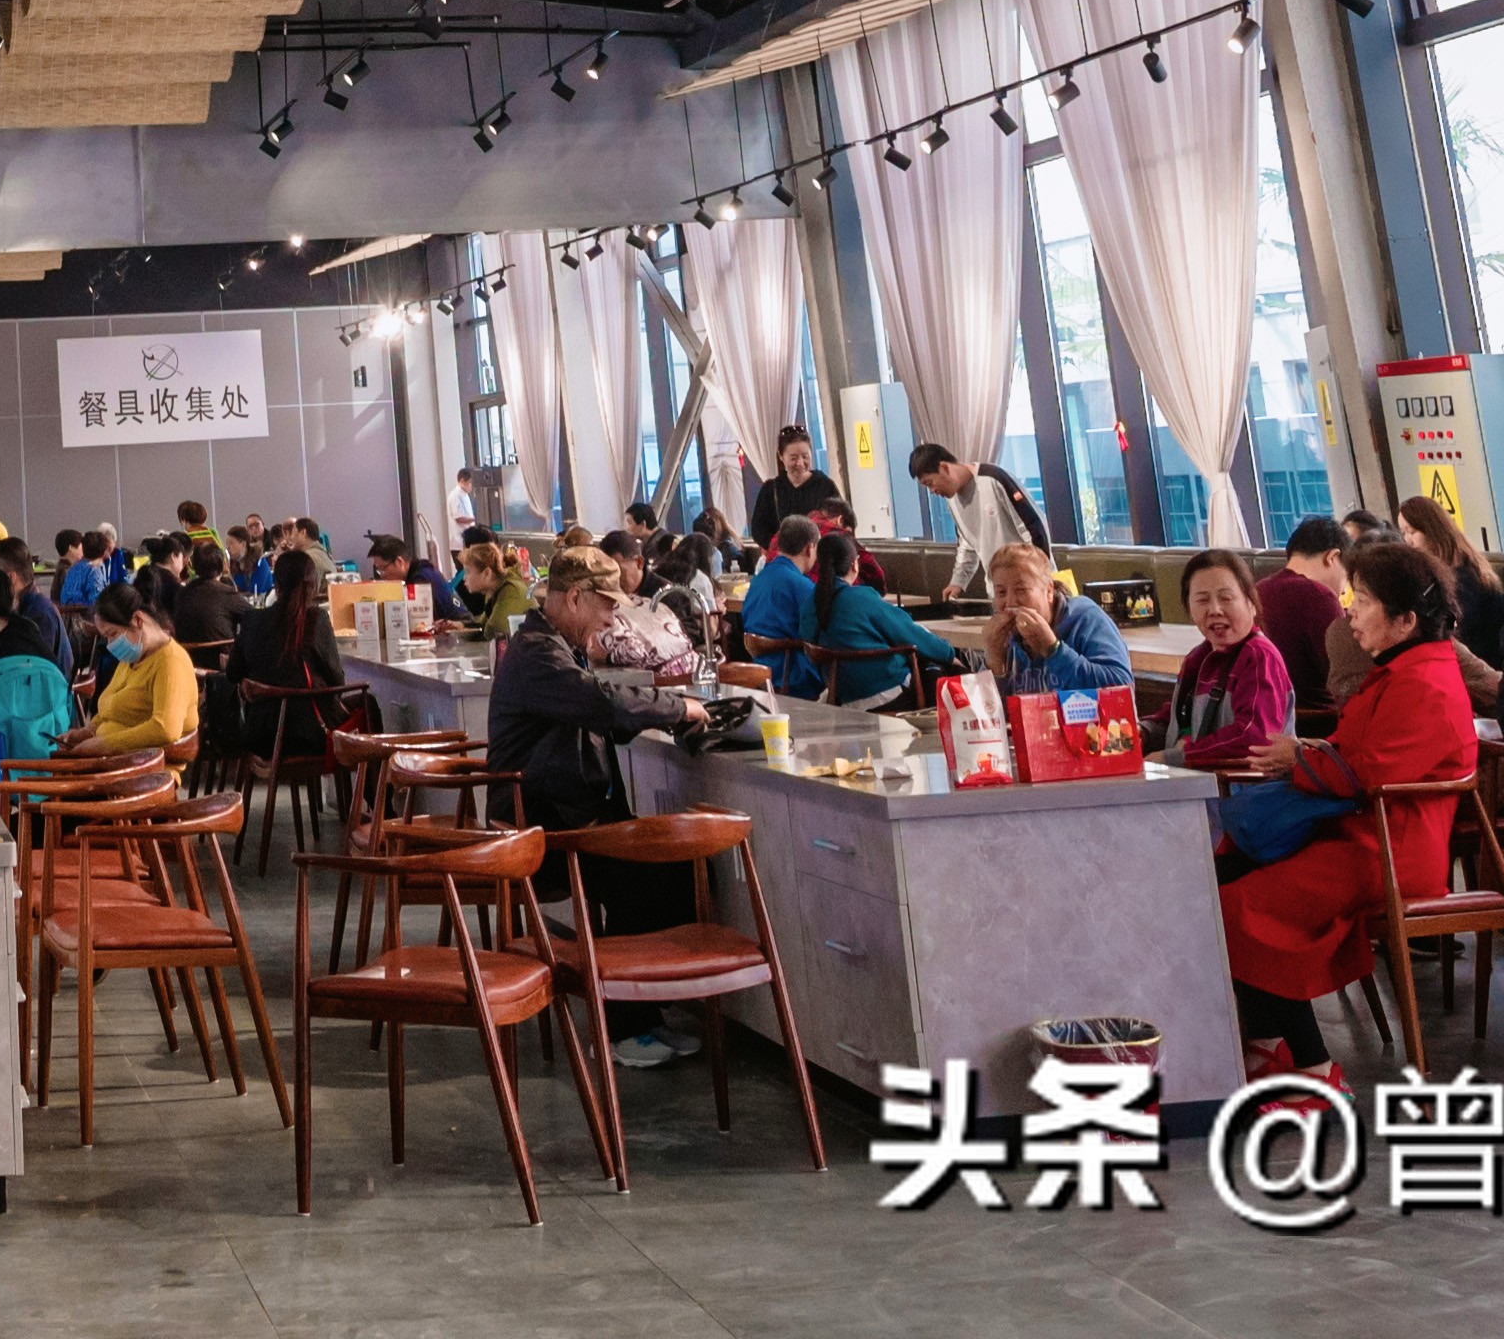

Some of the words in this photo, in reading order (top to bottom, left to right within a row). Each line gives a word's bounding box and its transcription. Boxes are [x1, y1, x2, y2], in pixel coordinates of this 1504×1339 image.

[78, 384, 249, 428] 餐具收集处
